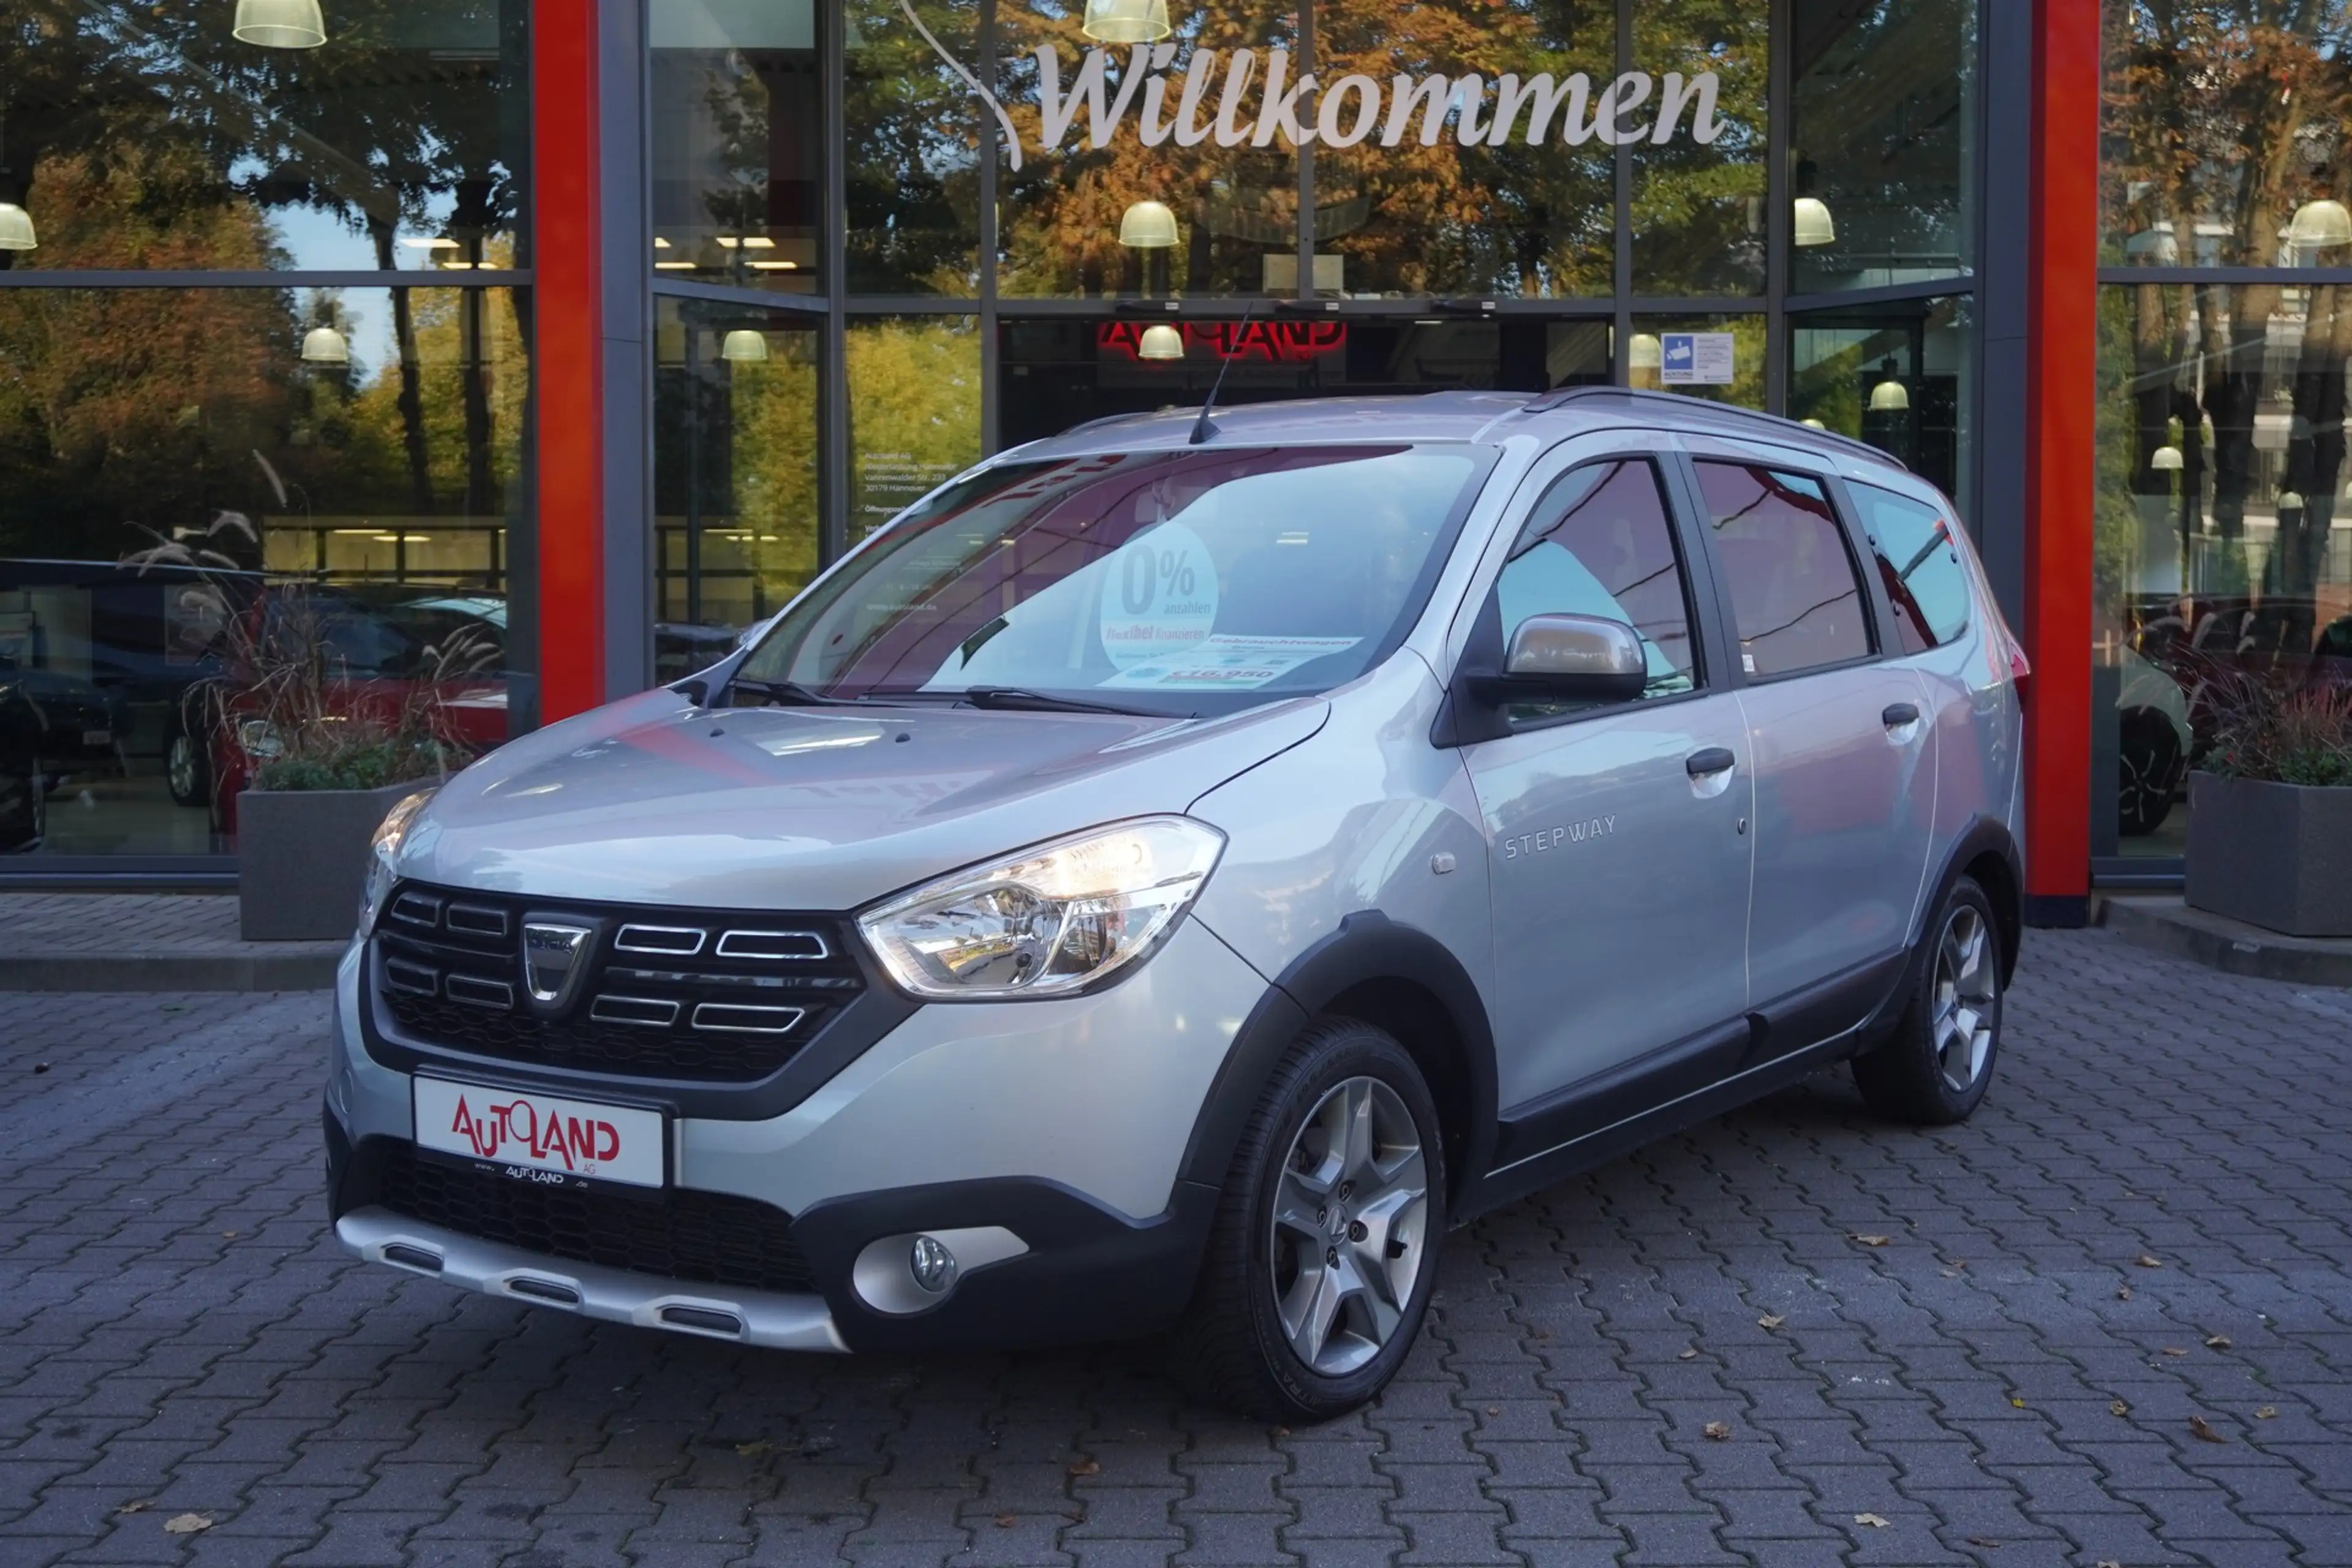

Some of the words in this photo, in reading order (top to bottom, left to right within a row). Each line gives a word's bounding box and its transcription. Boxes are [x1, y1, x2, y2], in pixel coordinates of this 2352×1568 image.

[1036, 43, 1725, 148] Willkommen
[1164, 601, 1211, 615] anzahlen
[1155, 628, 1204, 640] finanzieren
[1210, 637, 1352, 646] Gebrauchtwagen
[1504, 814, 1617, 859] STEPWAY
[452, 1093, 620, 1170] AUTOLAND
[506, 1166, 564, 1184] AUTOLAND
[582, 1163, 596, 1175] AG
